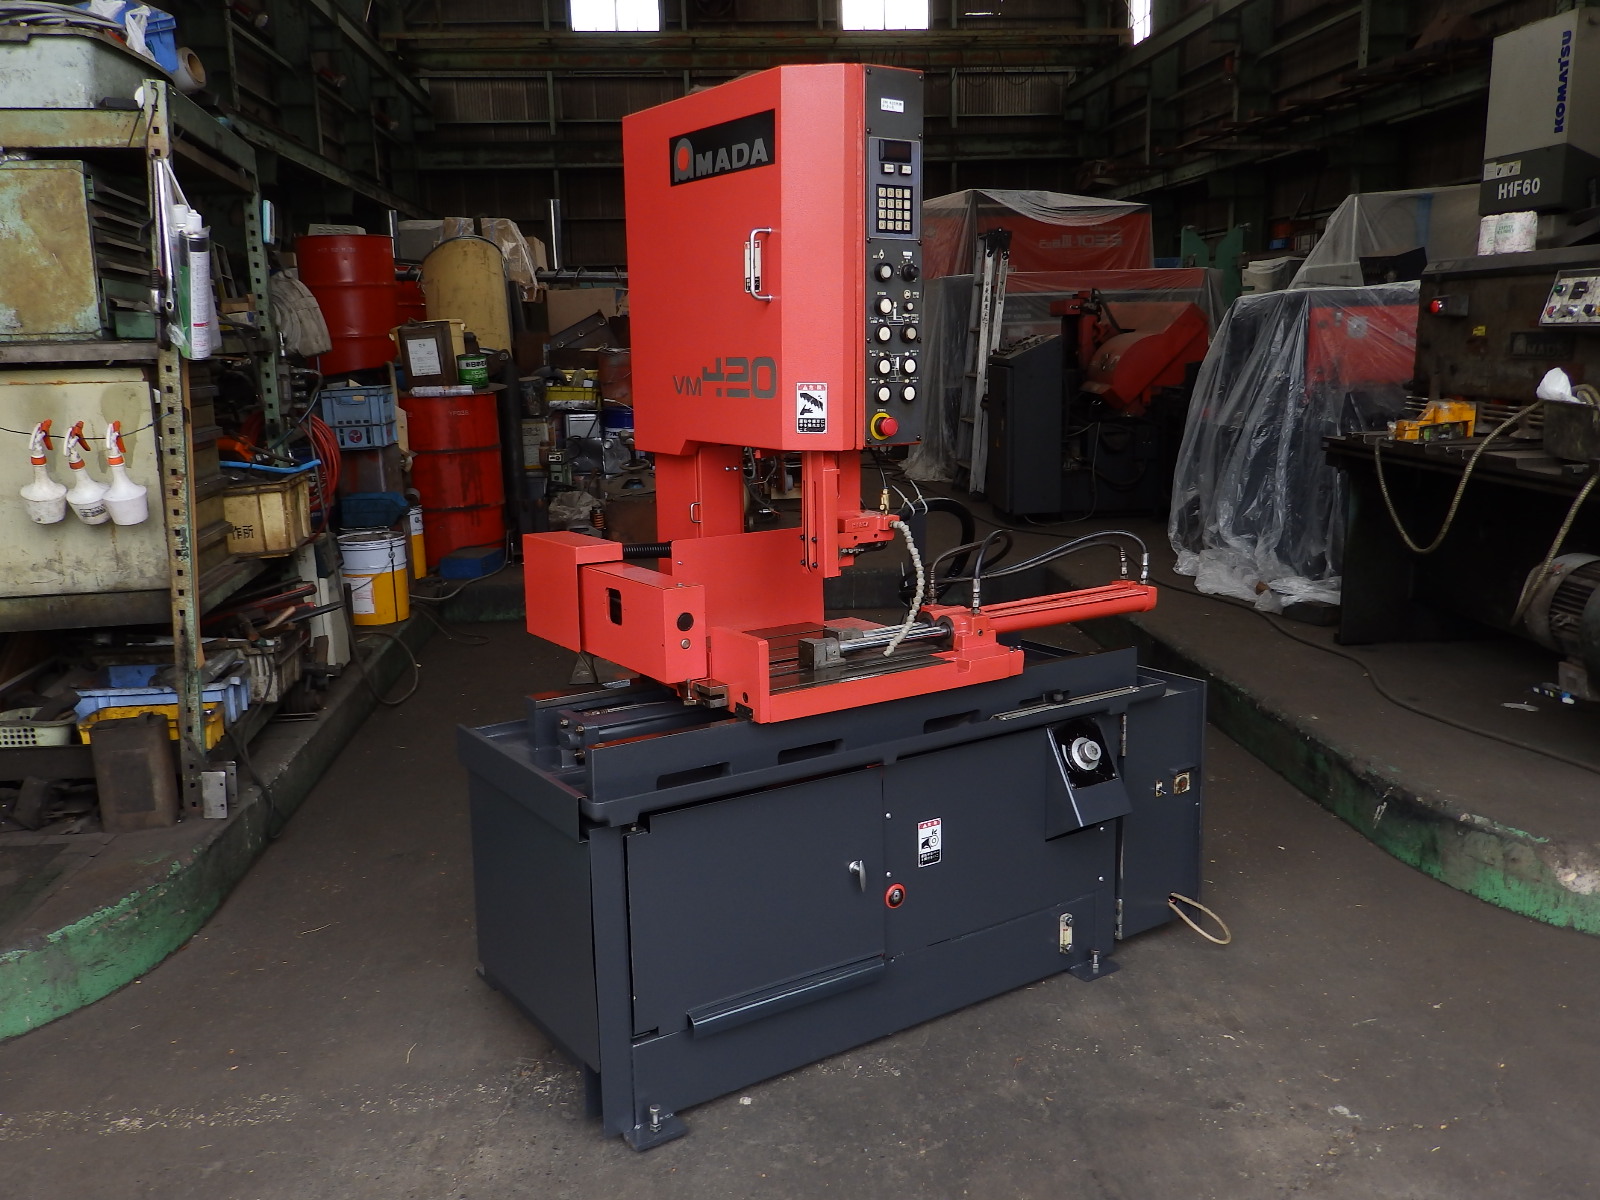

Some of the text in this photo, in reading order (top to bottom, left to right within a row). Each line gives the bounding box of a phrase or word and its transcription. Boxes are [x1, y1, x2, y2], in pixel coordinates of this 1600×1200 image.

[1554, 30, 1572, 133] KOMATSU
[673, 137, 769, 183] AMADA
[1498, 177, 1541, 200] H1F60
